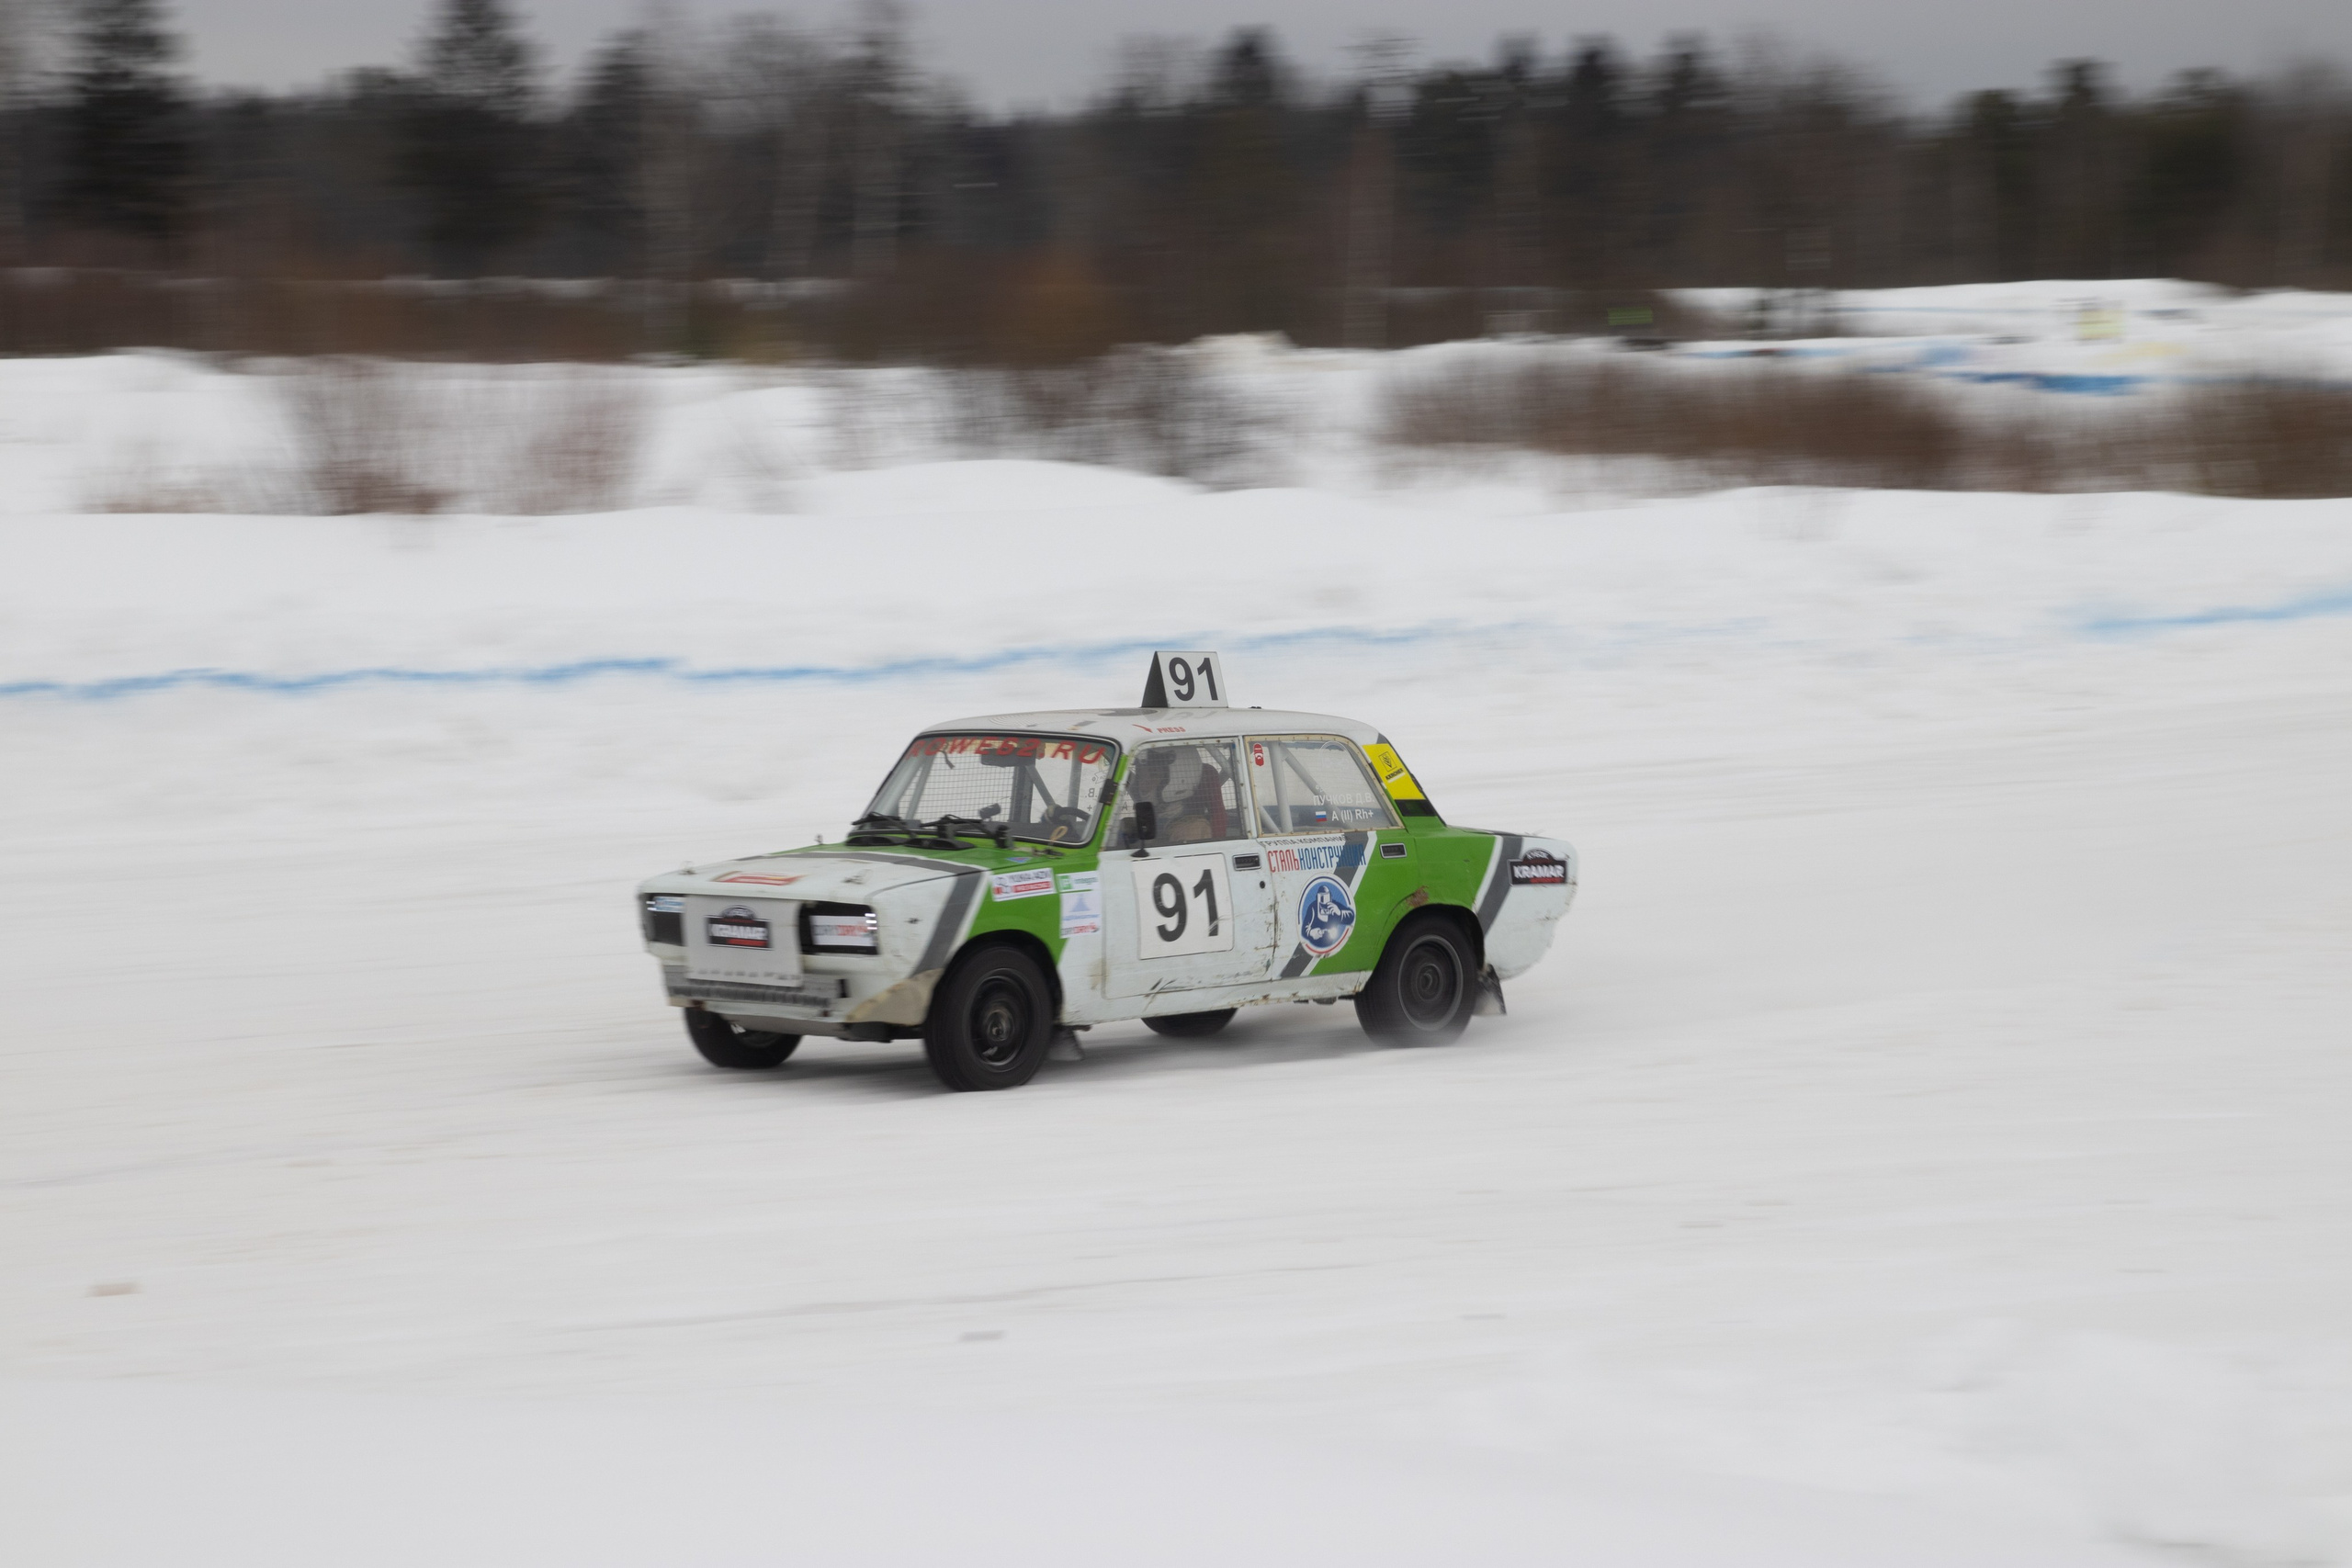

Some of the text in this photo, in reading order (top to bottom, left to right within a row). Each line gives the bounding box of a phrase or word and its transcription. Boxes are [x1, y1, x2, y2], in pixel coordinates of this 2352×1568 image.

[1169, 657, 1219, 702] 91
[1156, 726, 1186, 734] PRESS
[1312, 794, 1353, 807] ПУЧКОВ
[1355, 807, 1374, 820] Rh+
[1260, 838, 1298, 847] ГРУППА
[1512, 863, 1566, 879] KRAMAR
[1152, 868, 1219, 942] 91
